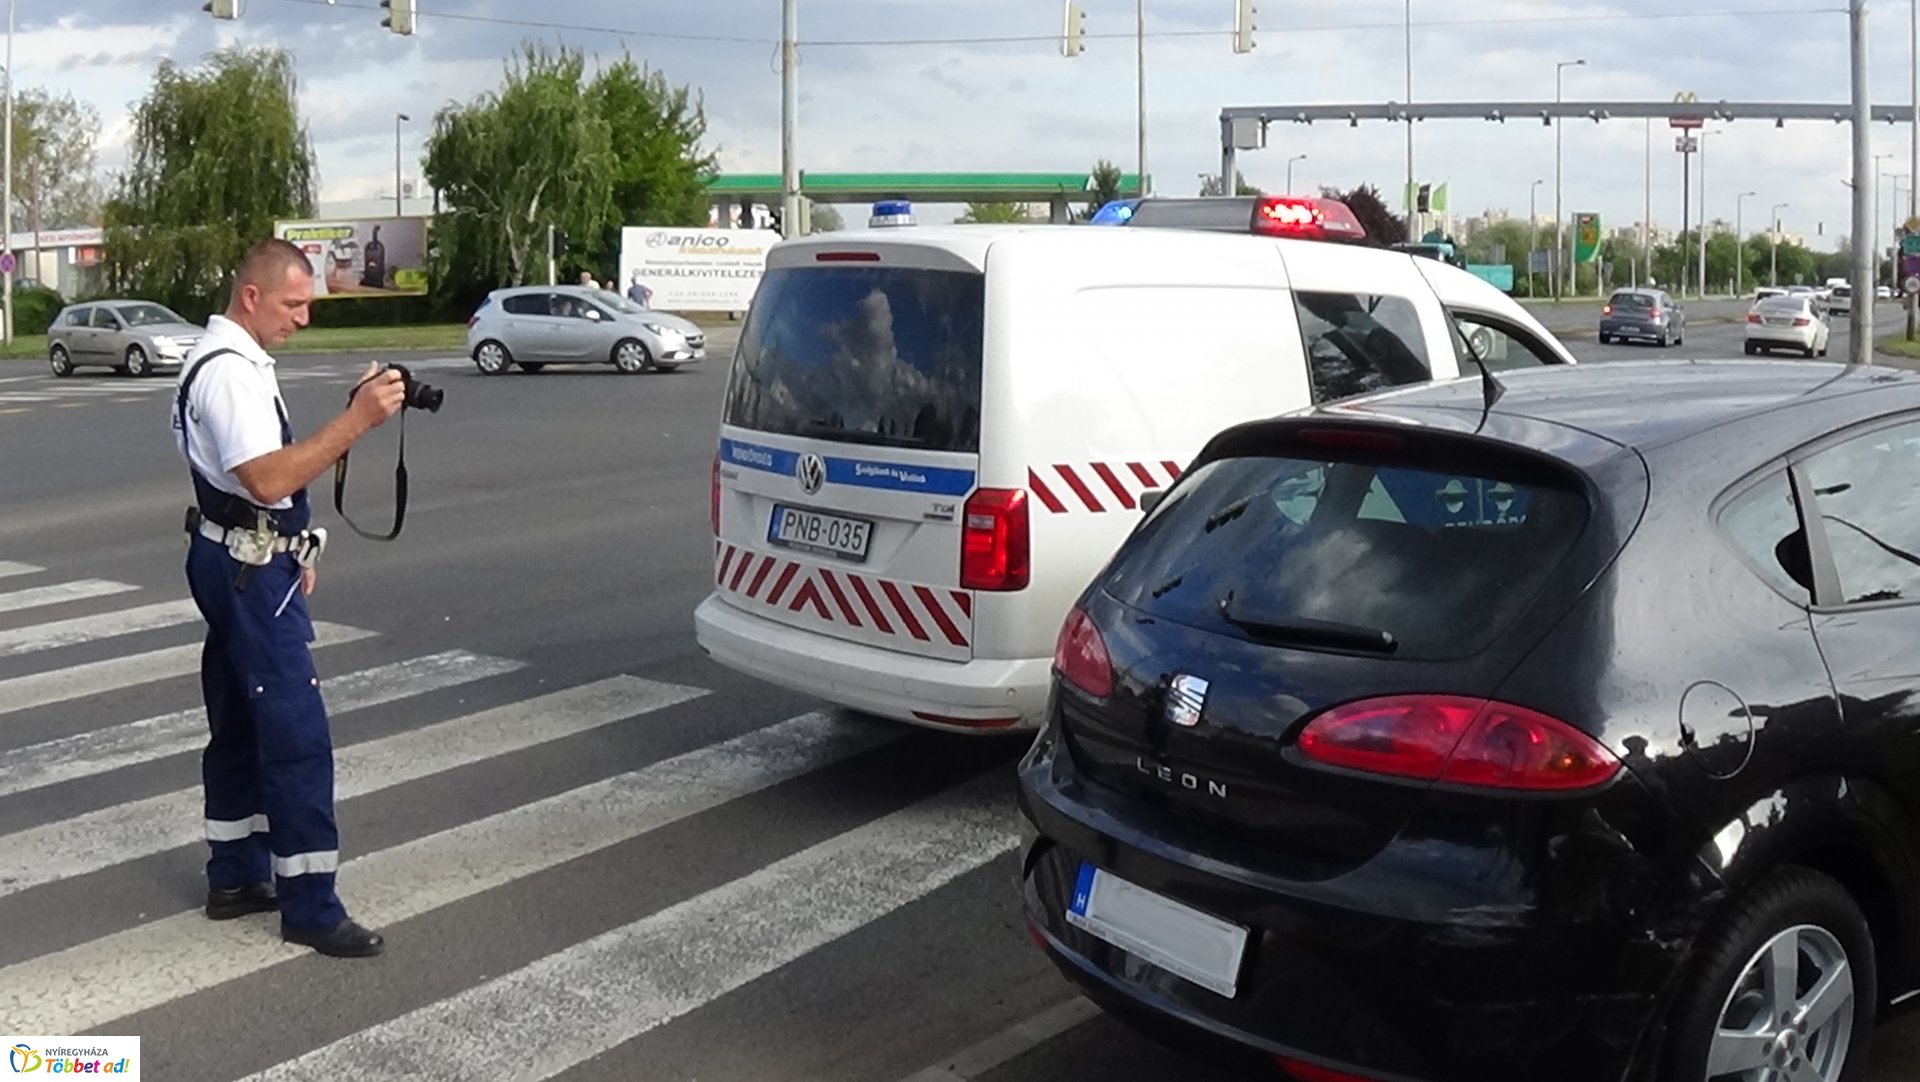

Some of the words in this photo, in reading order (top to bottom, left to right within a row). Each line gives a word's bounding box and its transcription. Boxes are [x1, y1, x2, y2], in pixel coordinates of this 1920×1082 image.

[667, 233, 730, 247] anico
[782, 511, 864, 551] PNB-035
[1137, 757, 1227, 798] LEON
